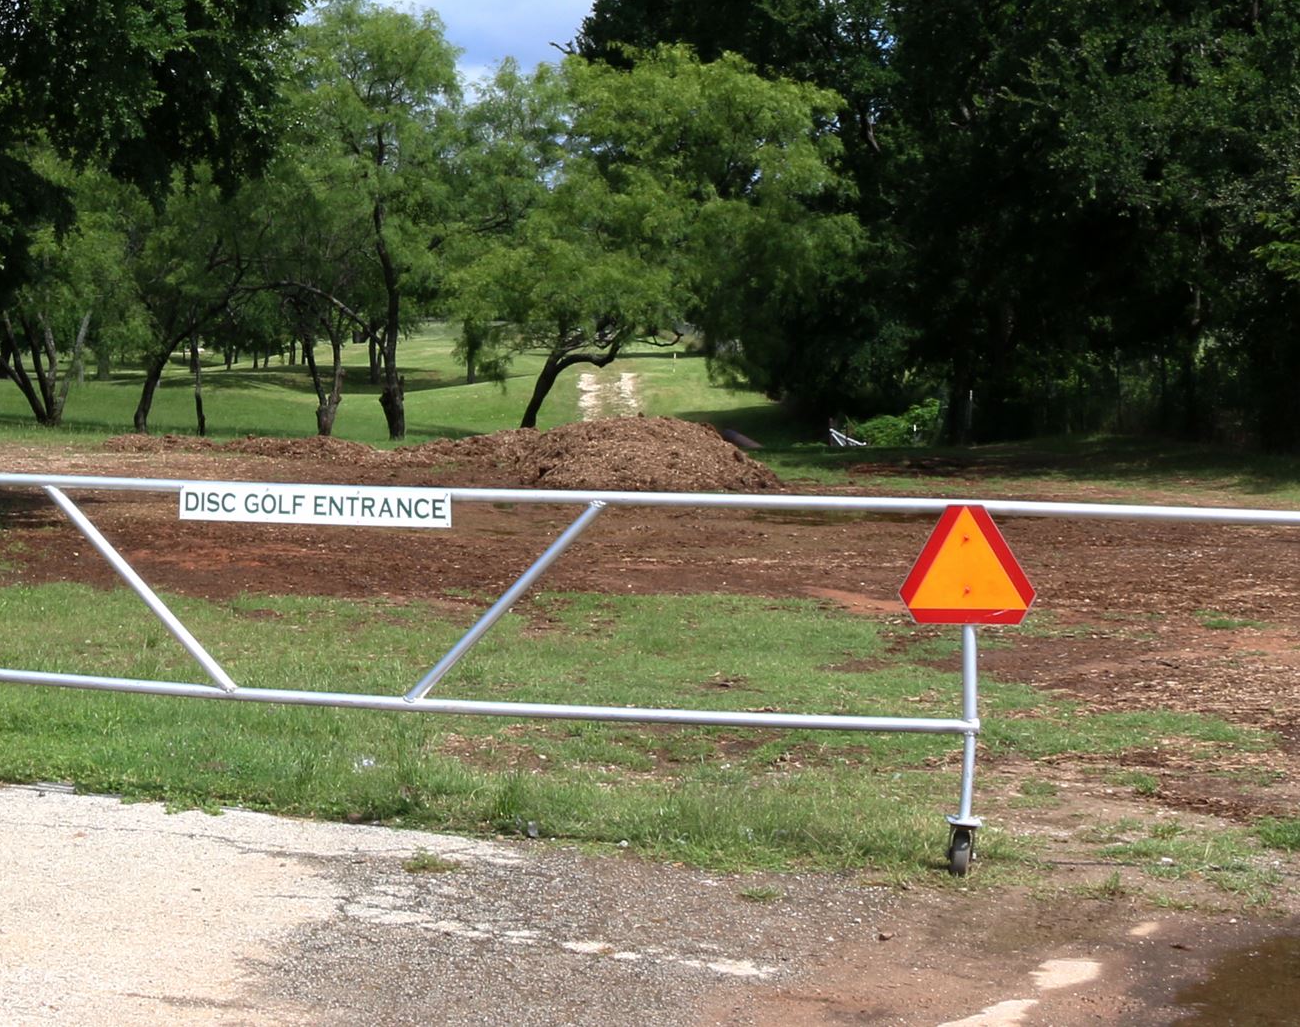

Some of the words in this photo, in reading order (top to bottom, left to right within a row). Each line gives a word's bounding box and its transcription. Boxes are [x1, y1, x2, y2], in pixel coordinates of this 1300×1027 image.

[184, 491, 236, 513] DISC
[244, 493, 306, 515] GOLF
[313, 495, 447, 520] ENTRANCE
